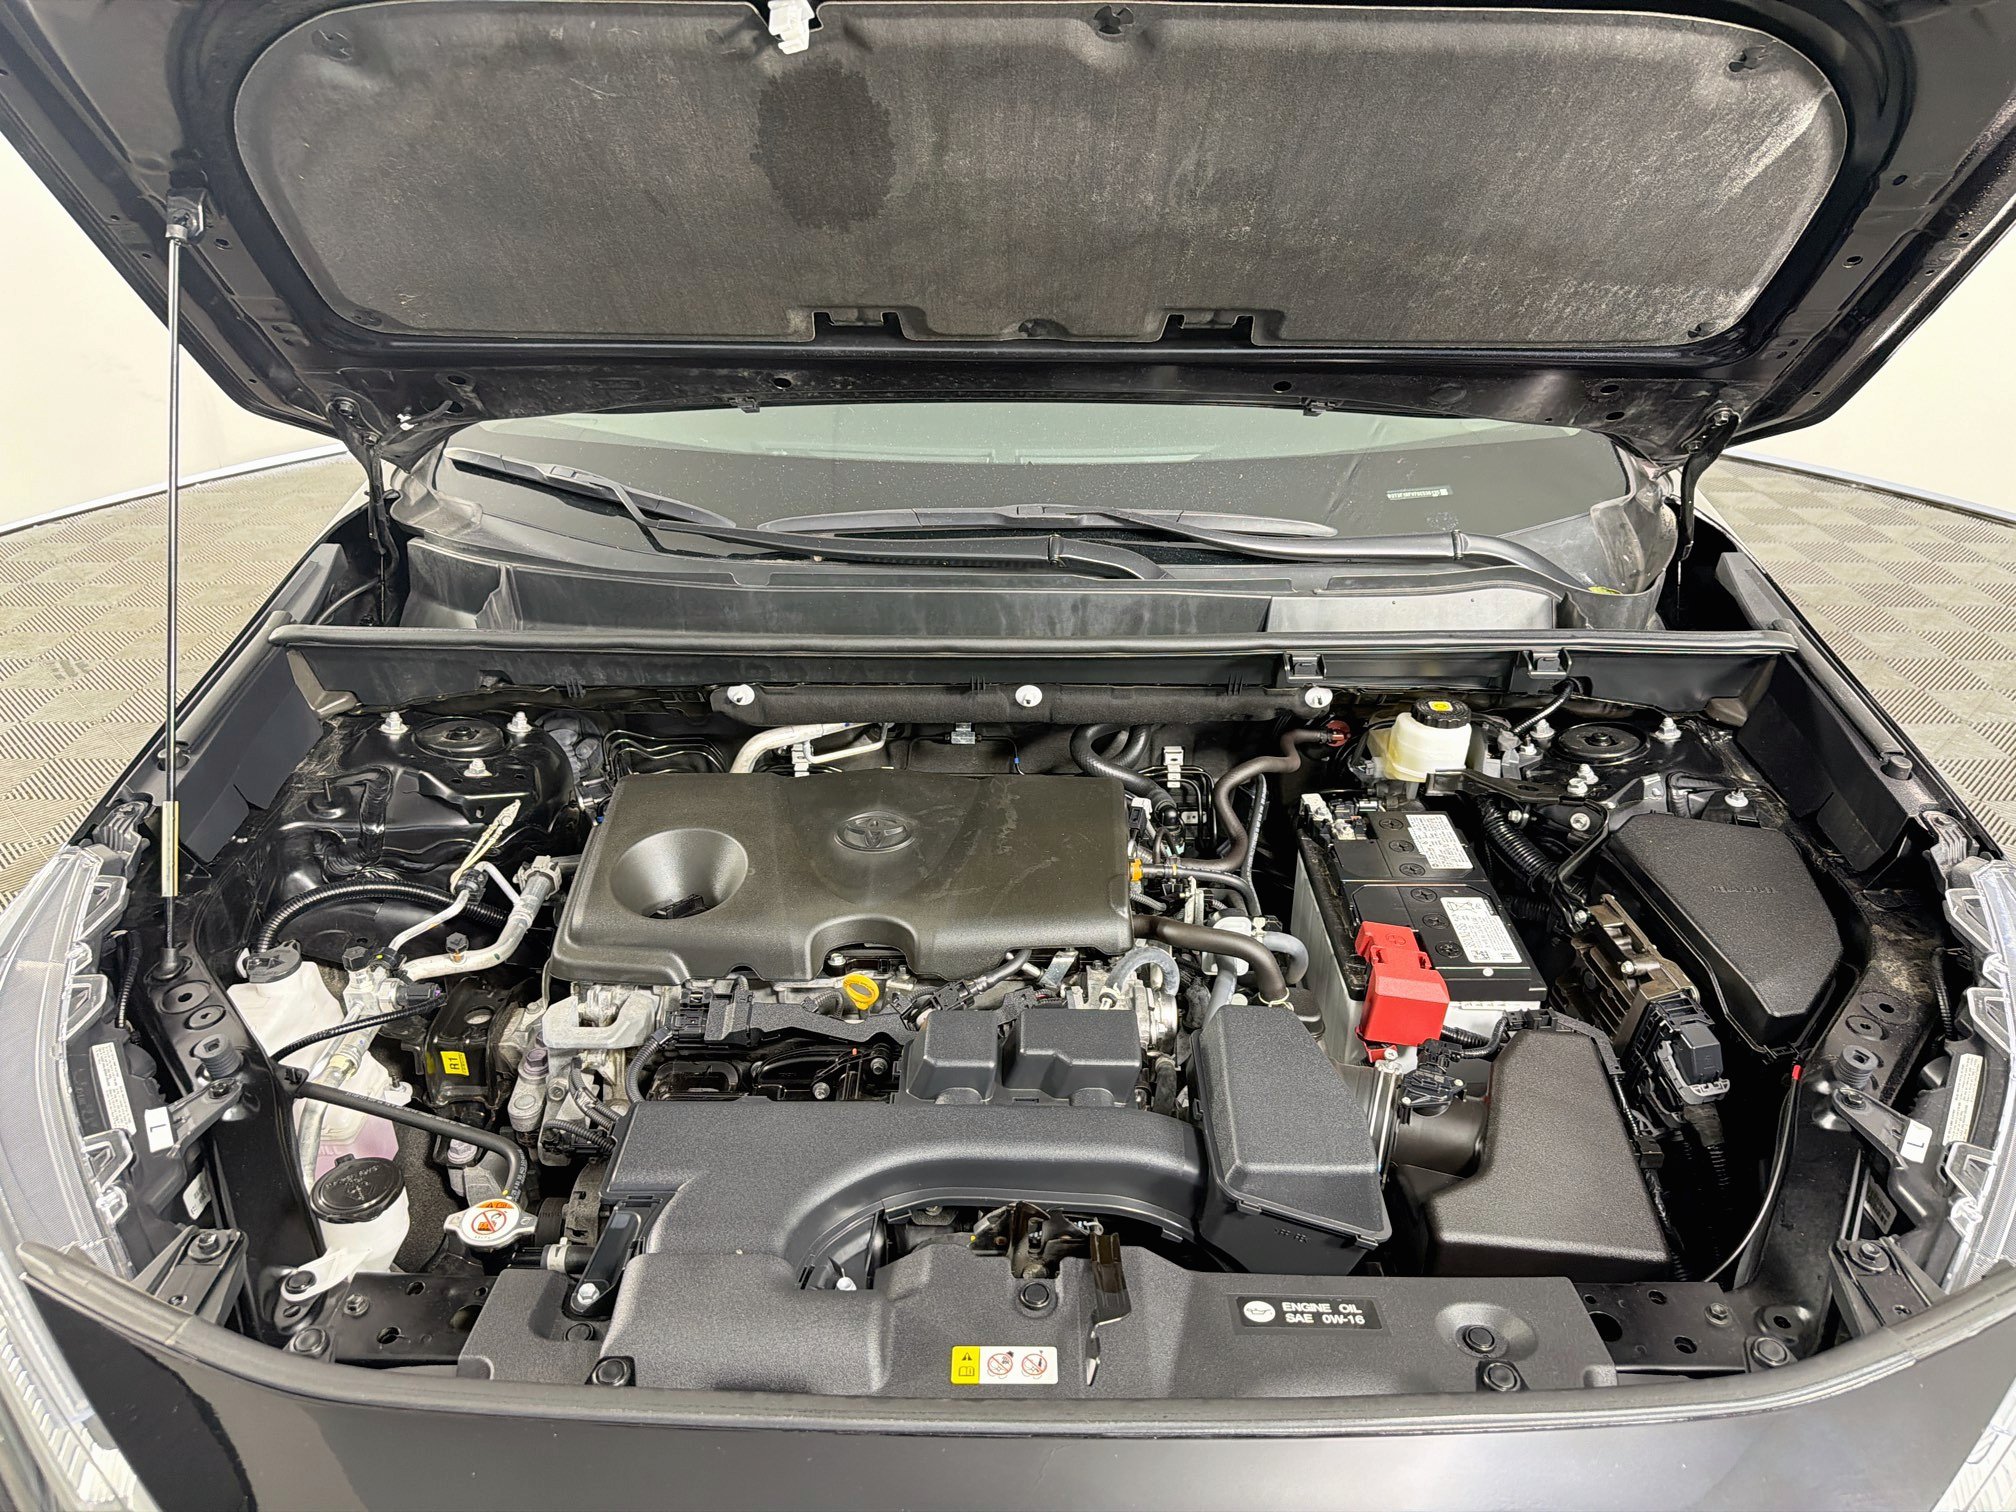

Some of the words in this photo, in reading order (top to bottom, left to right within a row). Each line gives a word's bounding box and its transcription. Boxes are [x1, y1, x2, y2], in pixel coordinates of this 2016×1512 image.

[1281, 1302, 1332, 1313] ENGINE
[1338, 1304, 1362, 1314] OIL
[1285, 1313, 1314, 1324] SAE
[1322, 1314, 1365, 1325] 0W-16
